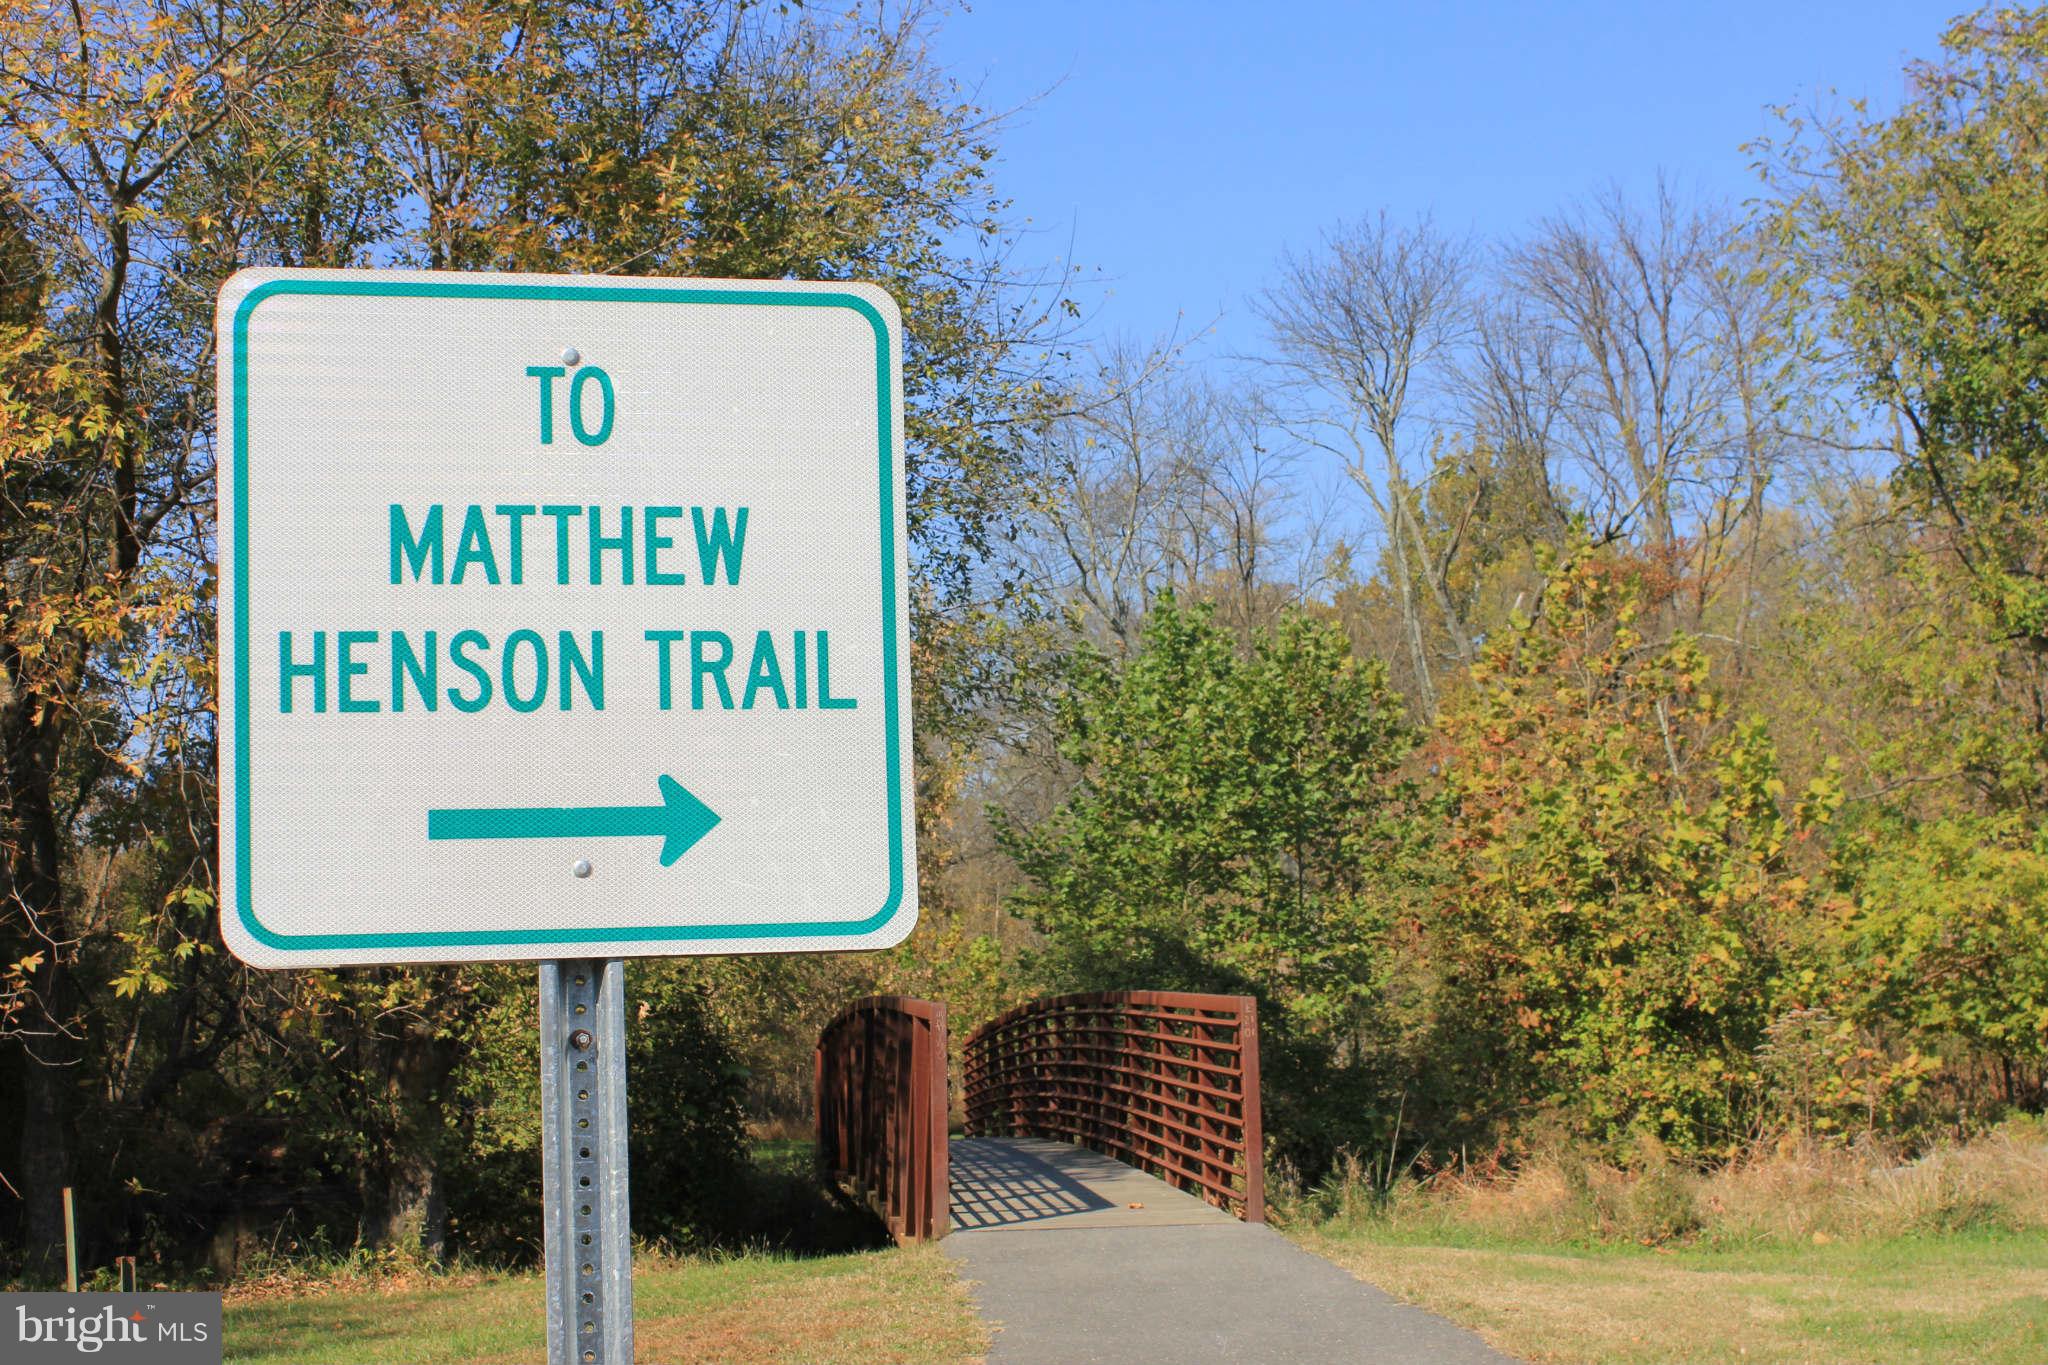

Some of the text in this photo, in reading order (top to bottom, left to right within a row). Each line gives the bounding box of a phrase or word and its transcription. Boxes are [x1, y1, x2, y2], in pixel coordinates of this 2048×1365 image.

[525, 365, 615, 447] TO
[388, 503, 750, 586] MATTHEW
[278, 629, 858, 714] HENSON TRAIL
